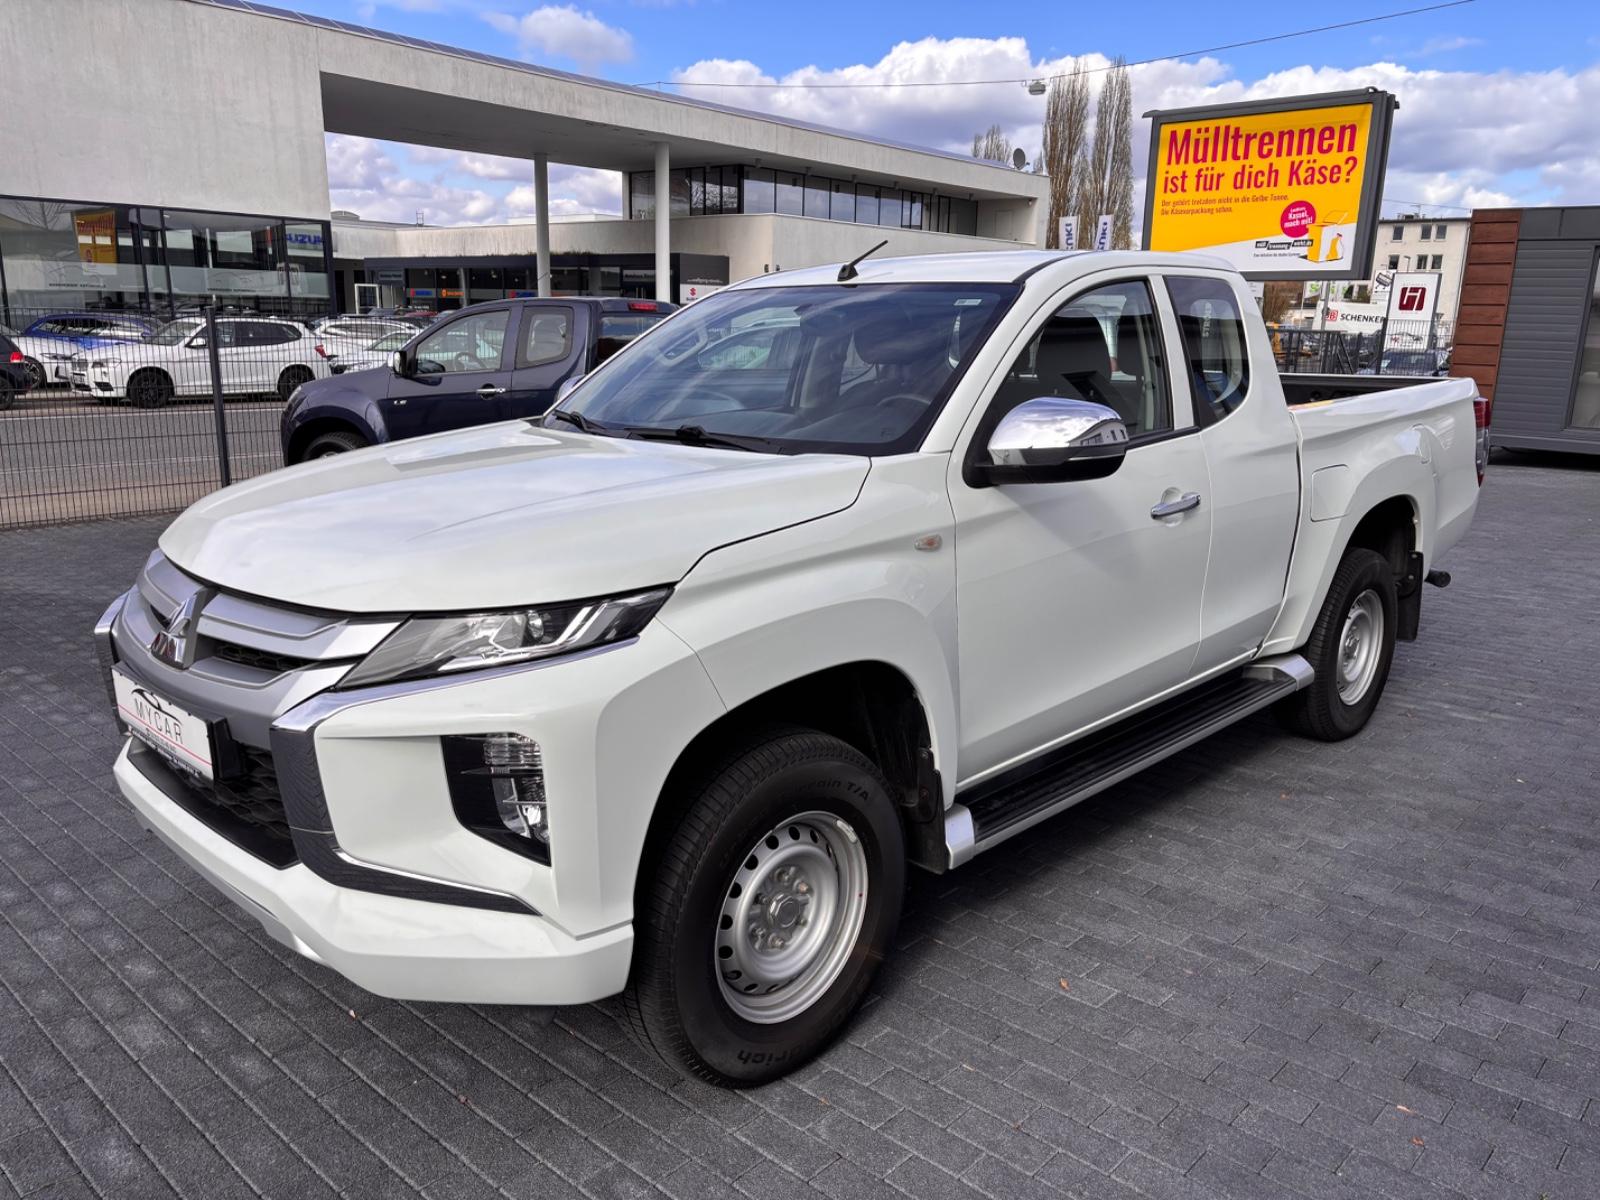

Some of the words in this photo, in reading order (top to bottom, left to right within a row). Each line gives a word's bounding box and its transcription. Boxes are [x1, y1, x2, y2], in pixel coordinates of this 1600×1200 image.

[1167, 123, 1358, 166] Mülltrennen
[1163, 170, 1187, 194] ist
[1195, 166, 1225, 192] für
[1233, 162, 1279, 190] dich
[1288, 156, 1358, 187] Käse?
